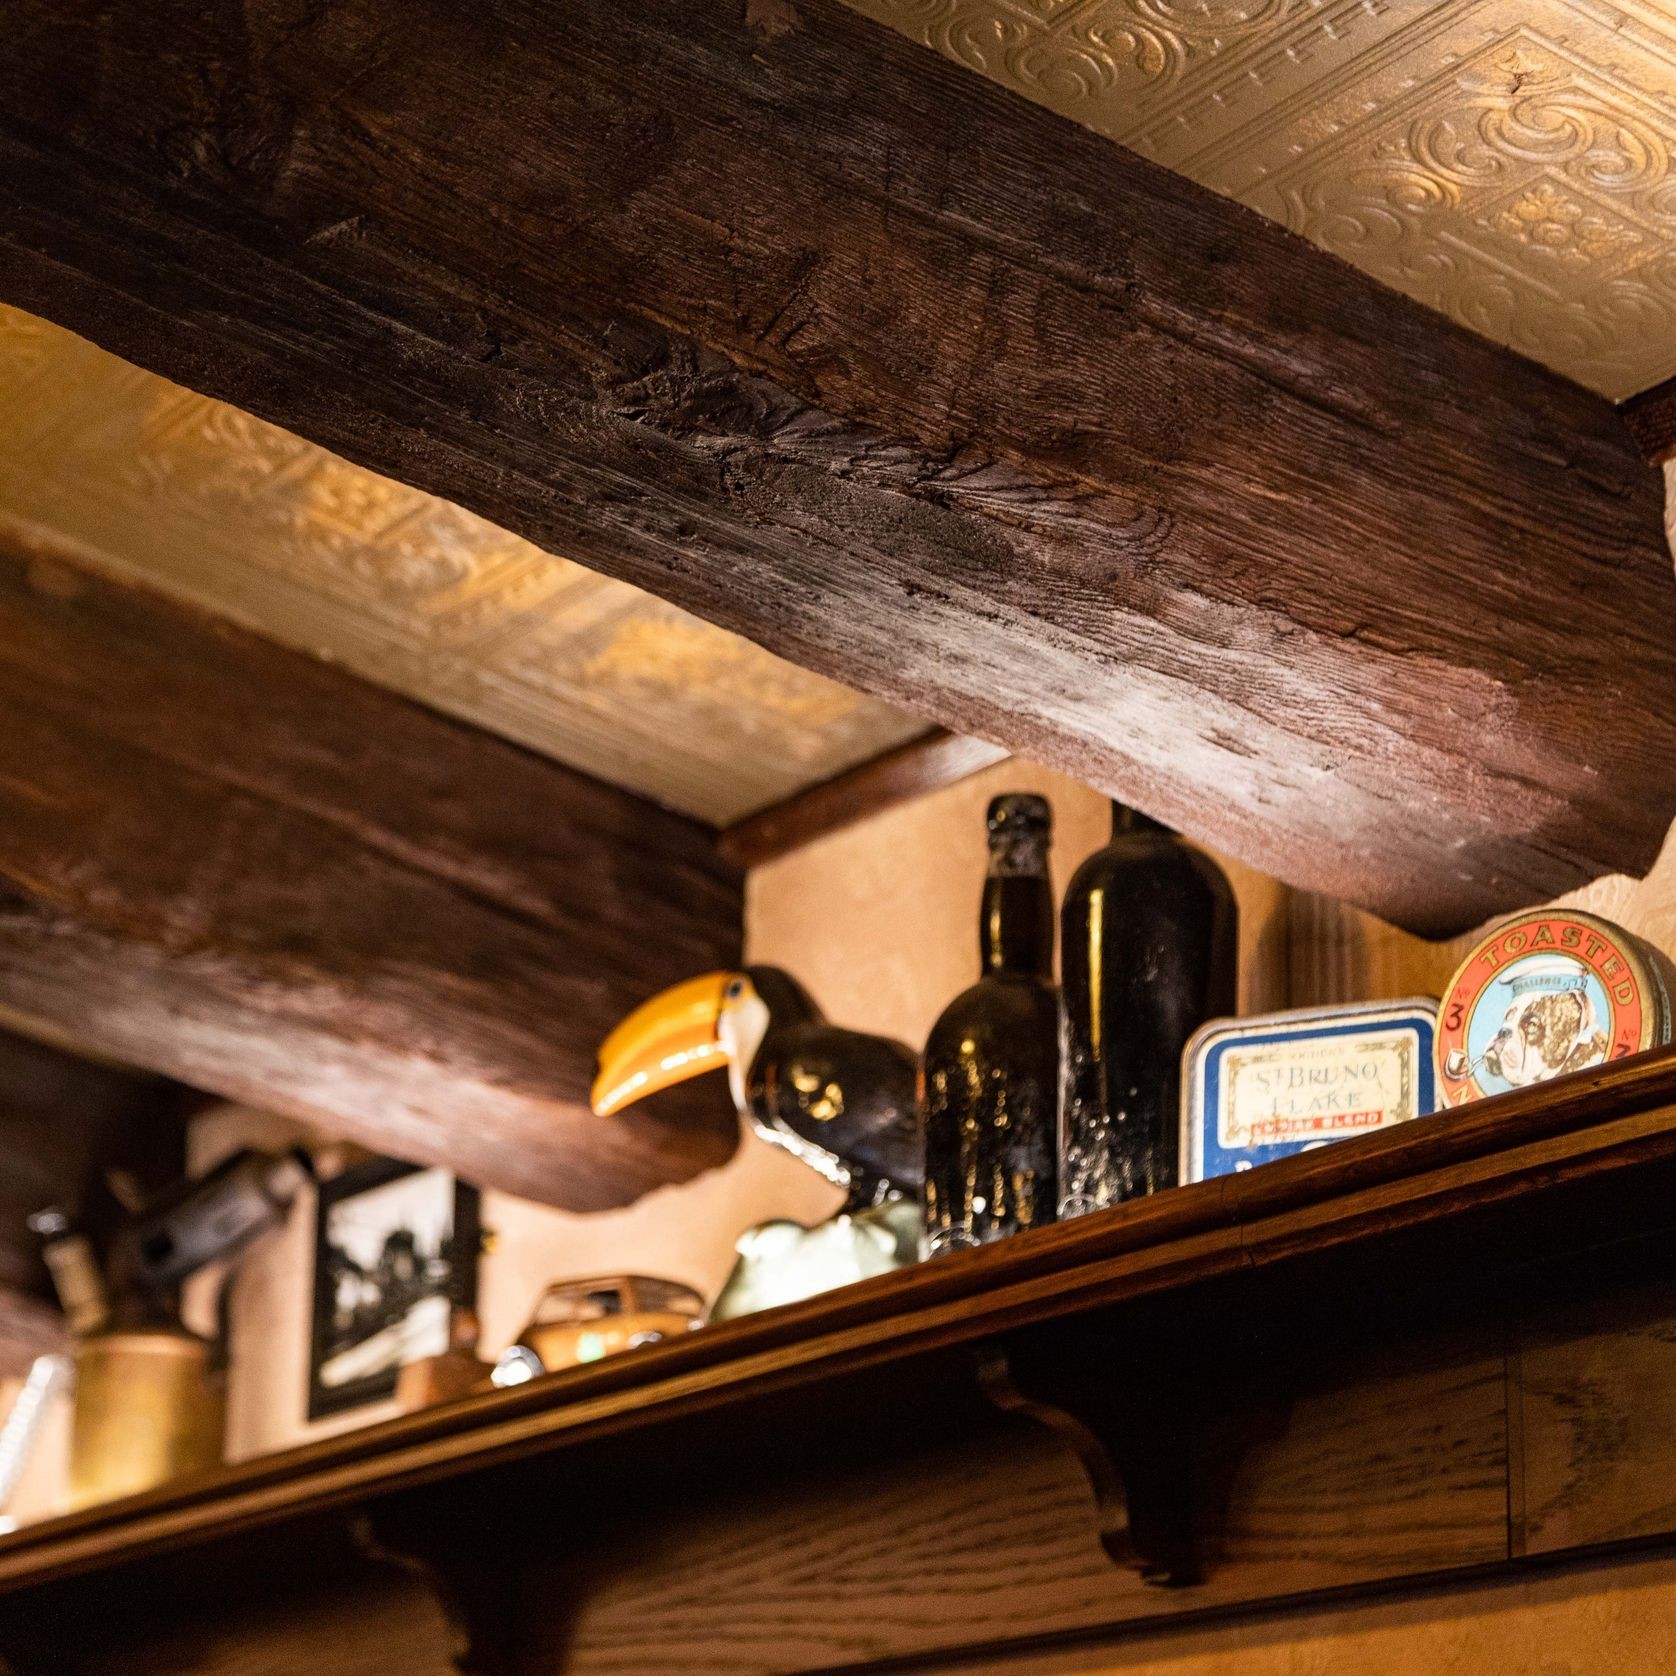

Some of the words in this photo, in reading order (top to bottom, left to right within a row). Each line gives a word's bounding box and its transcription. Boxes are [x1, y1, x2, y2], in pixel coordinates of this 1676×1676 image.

[1480, 925, 1635, 1006] TOASTED
[1445, 1003, 1462, 1032] 3
[1288, 1062, 1378, 1088] BRUNO
